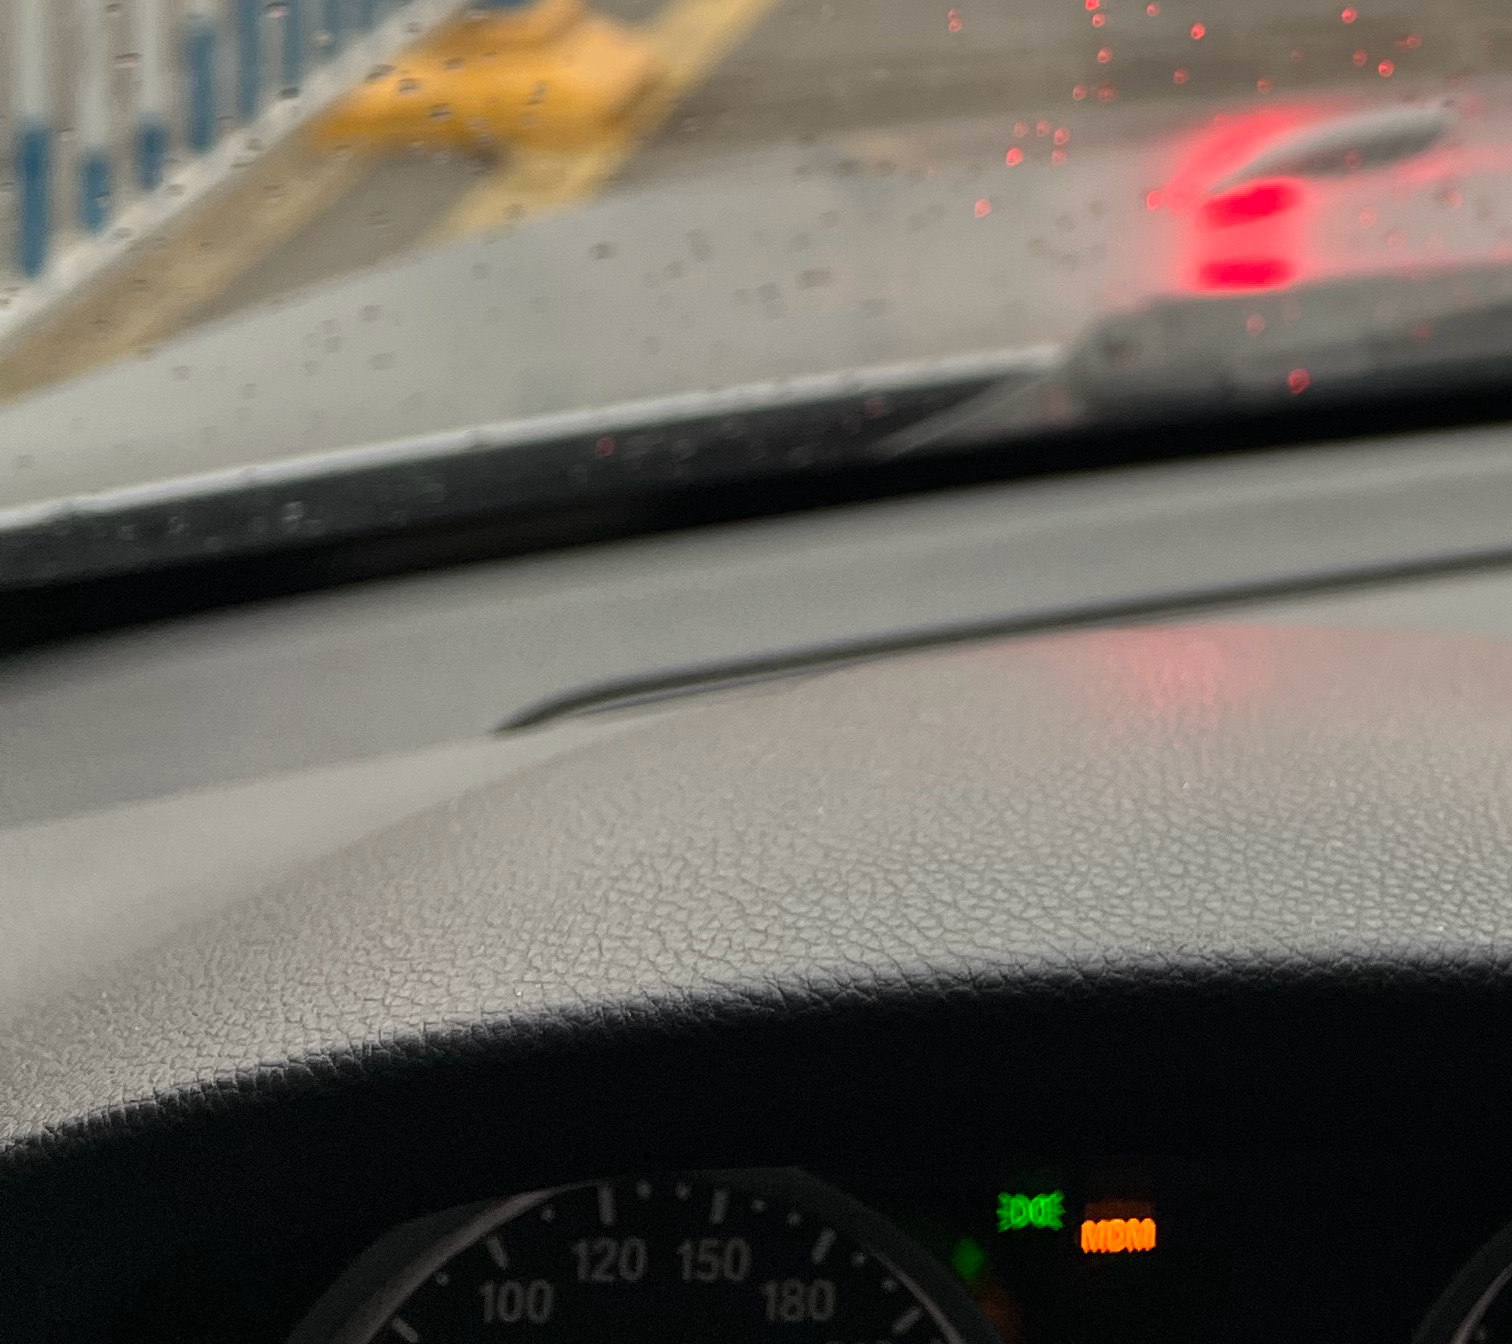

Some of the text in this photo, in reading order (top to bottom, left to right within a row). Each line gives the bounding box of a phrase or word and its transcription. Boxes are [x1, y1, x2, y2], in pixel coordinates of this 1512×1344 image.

[571, 1236, 648, 1283] 120
[675, 1235, 750, 1283] 150
[479, 1278, 553, 1324] 100
[760, 1278, 835, 1323] 180
